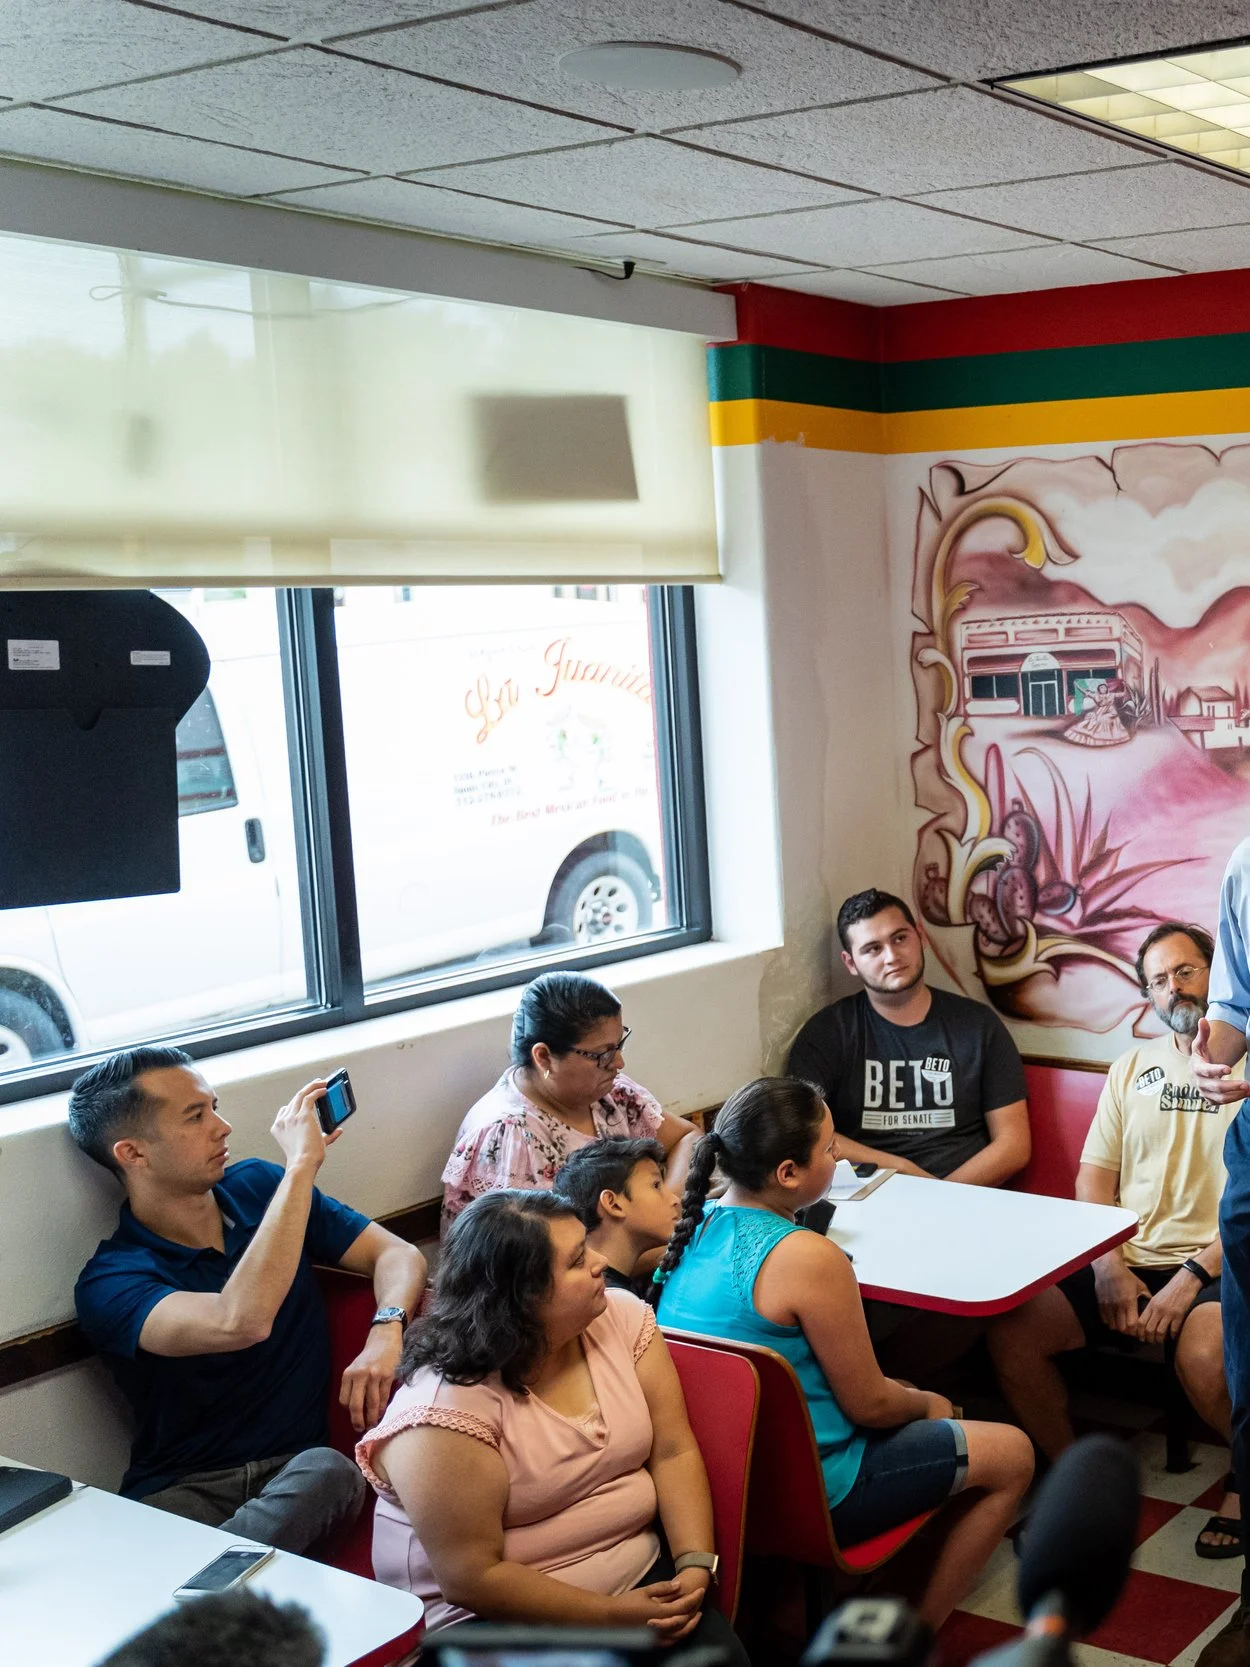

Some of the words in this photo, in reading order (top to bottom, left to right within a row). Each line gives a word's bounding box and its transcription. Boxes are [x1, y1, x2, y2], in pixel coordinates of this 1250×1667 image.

[925, 1056, 950, 1072] BETO
[864, 1059, 954, 1109] BETO
[1138, 1067, 1161, 1088] BETO
[883, 1114, 899, 1126] FOR
[902, 1112, 933, 1125] SENATE
